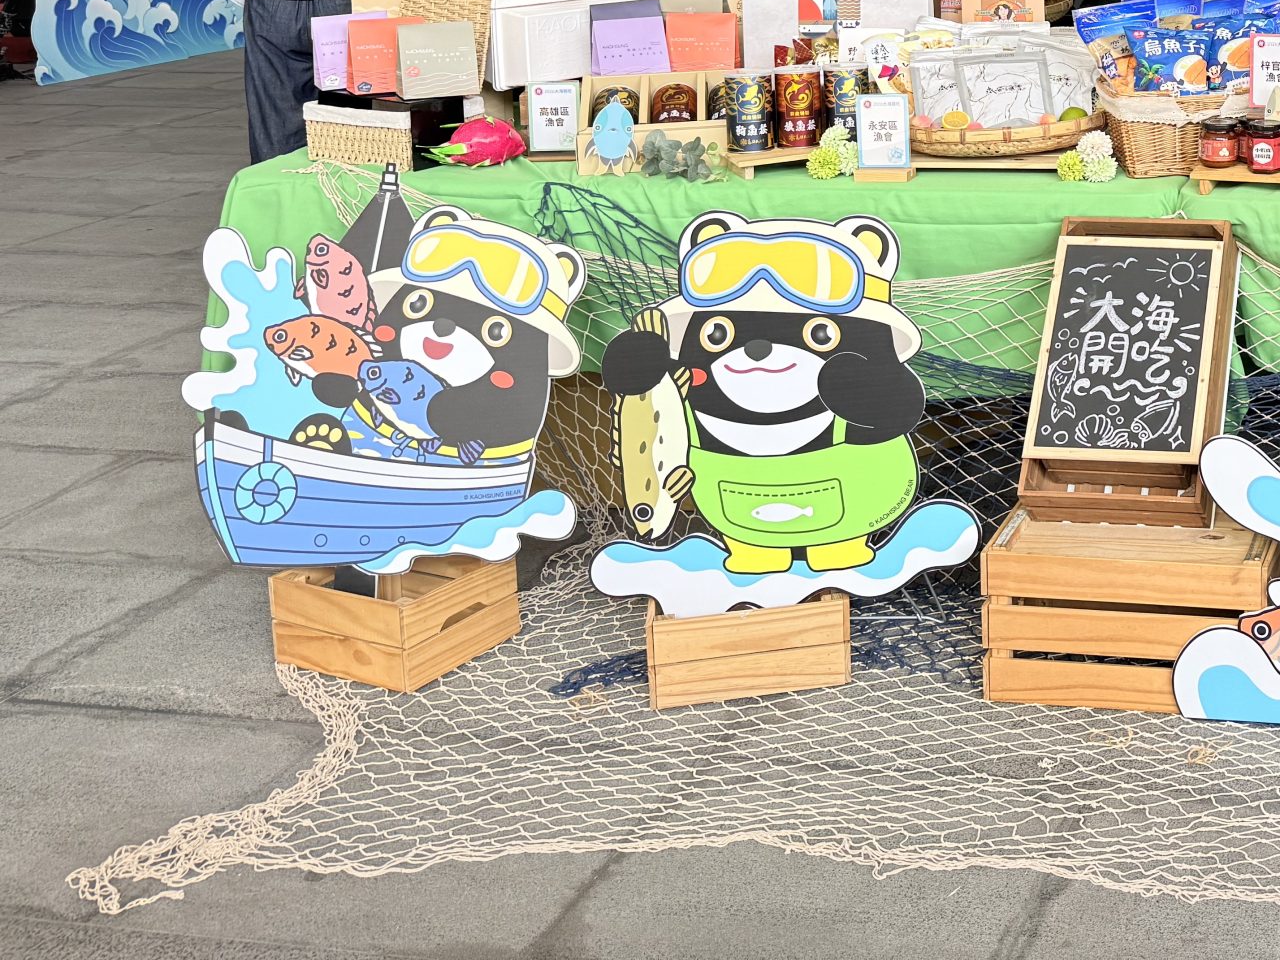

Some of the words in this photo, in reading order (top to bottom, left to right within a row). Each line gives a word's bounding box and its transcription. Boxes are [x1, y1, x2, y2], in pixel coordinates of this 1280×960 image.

[1144, 38, 1200, 57] 烏魚子
[539, 106, 570, 116] 高雄區
[545, 118, 565, 127] 漁會
[868, 120, 898, 130] 永安區
[873, 131, 893, 142] 漁會
[1079, 290, 1180, 340] 大海
[1078, 331, 1175, 384] 開吃
[469, 492, 505, 500] KAOHSIUNG
[505, 489, 522, 497] BEAR
[875, 497, 907, 524] KAOHSIUNG
[904, 479, 914, 496] BEAR
